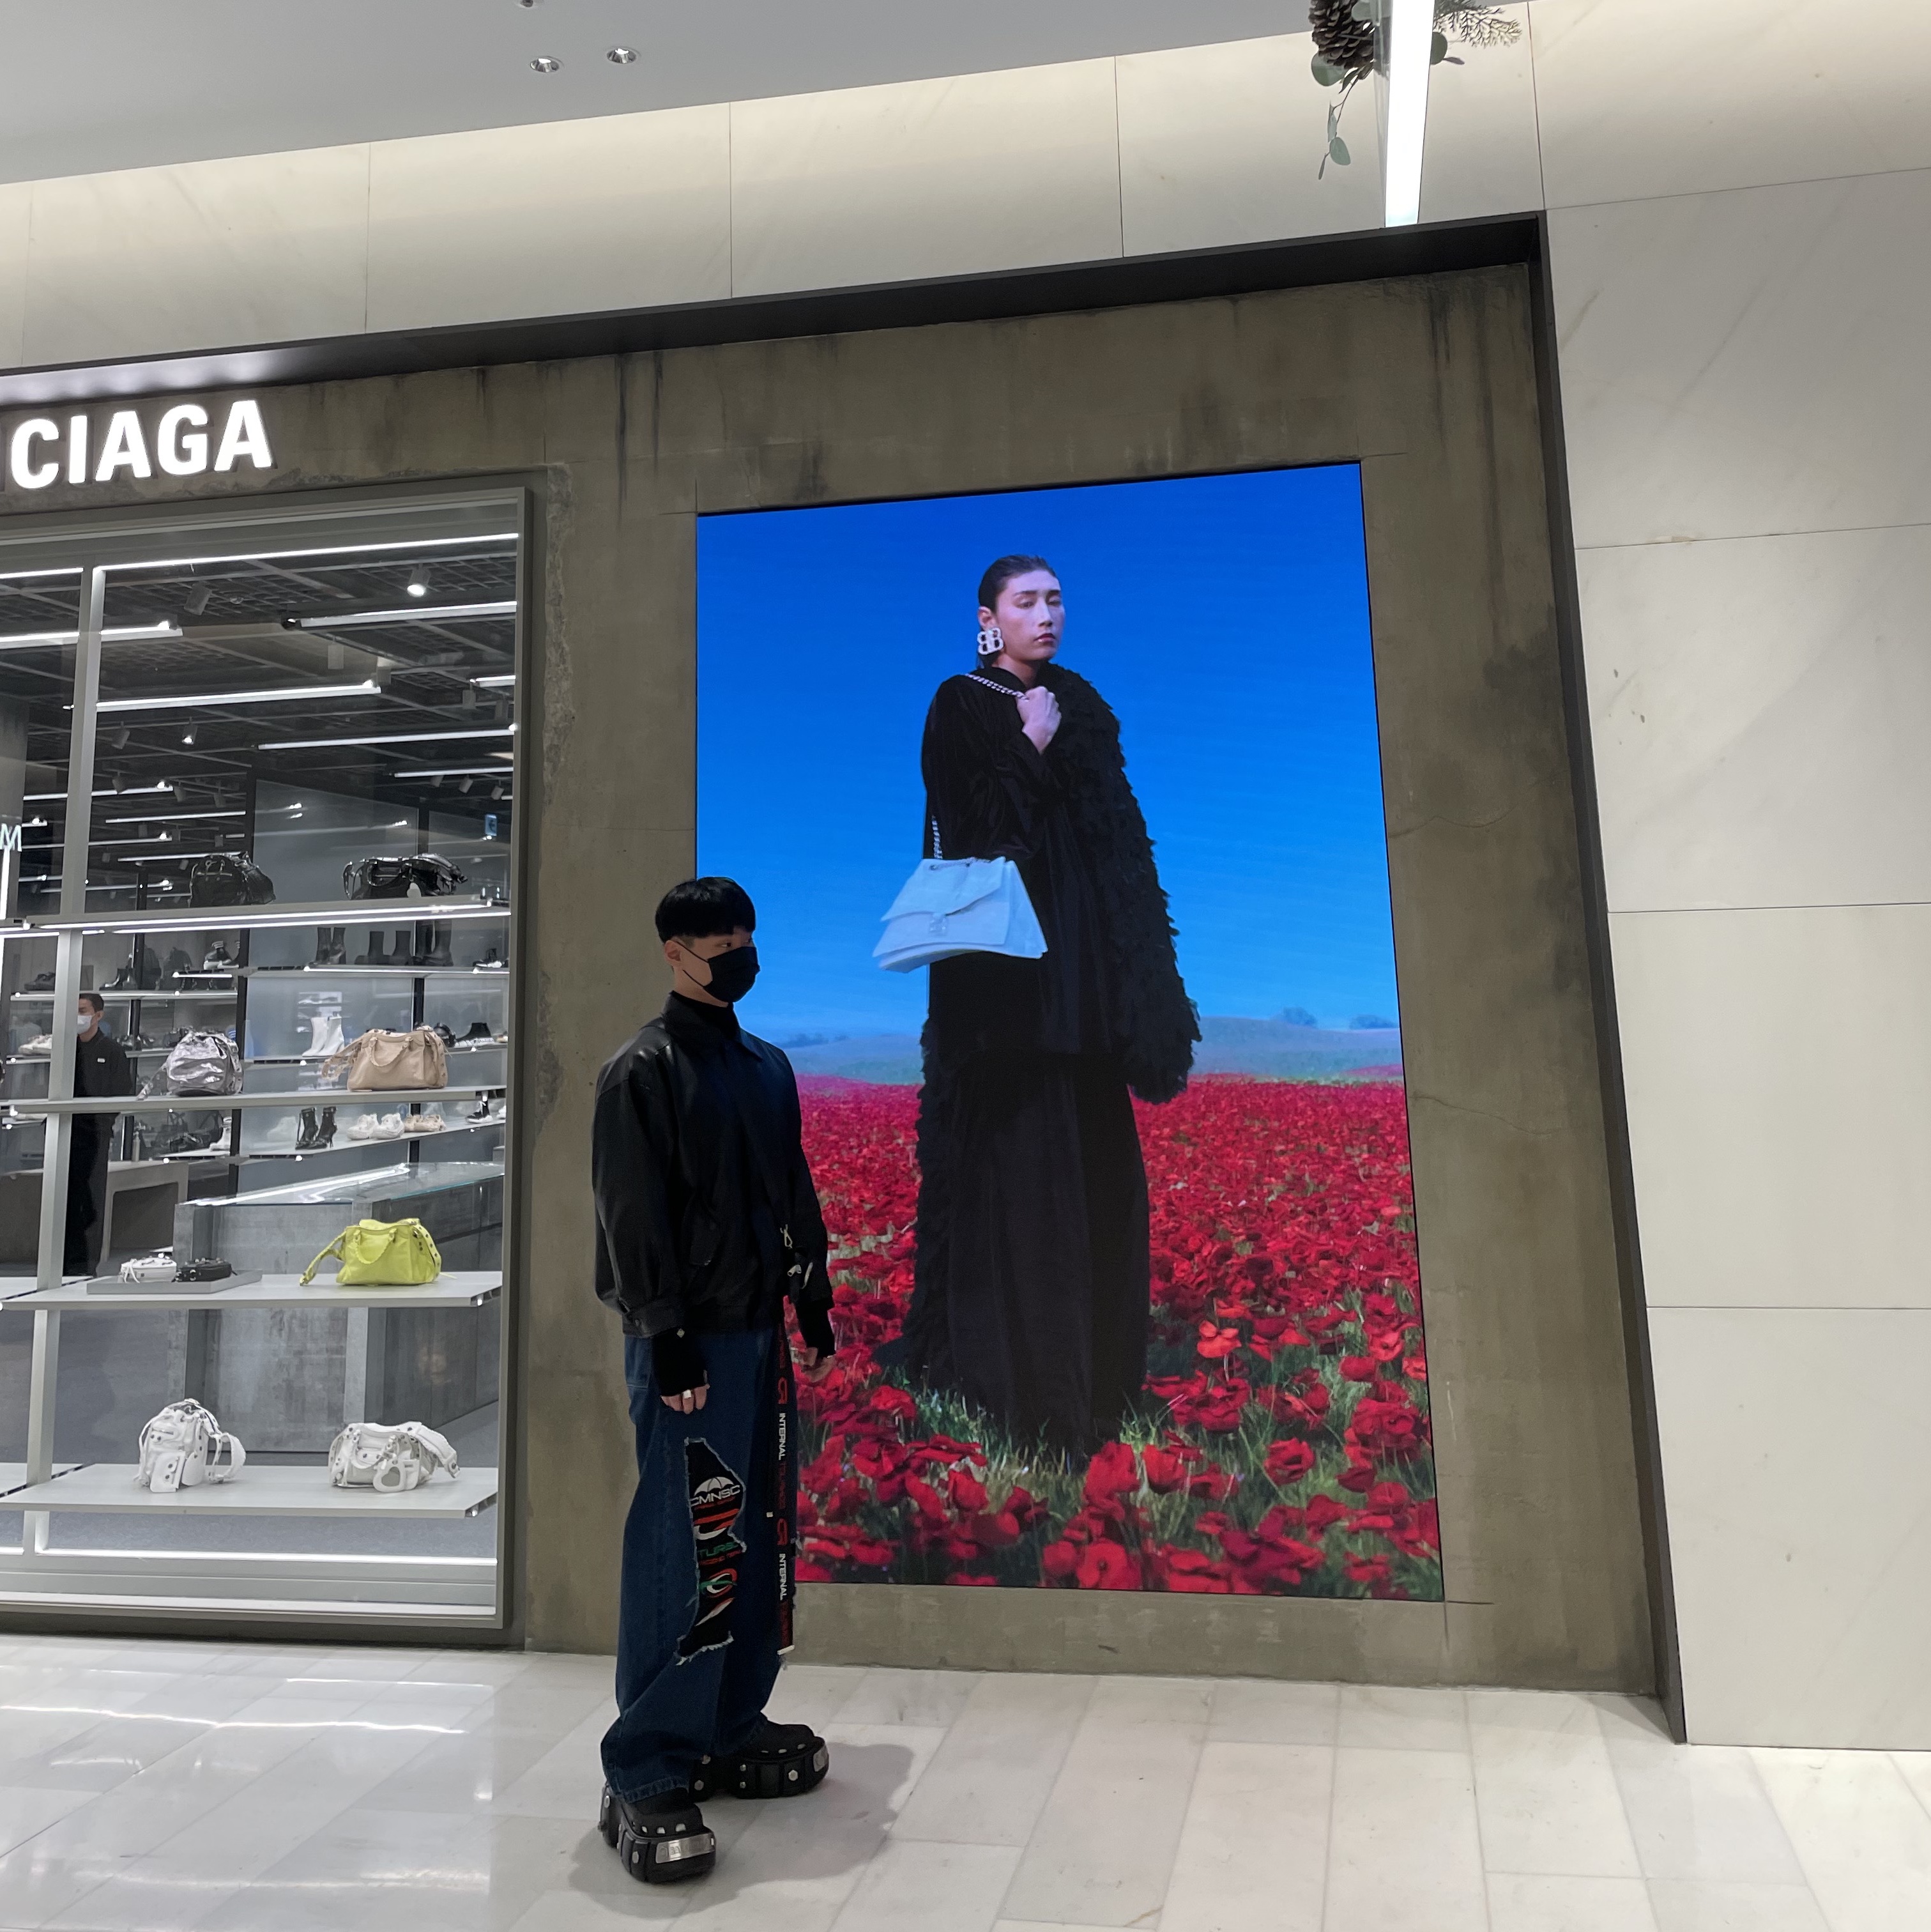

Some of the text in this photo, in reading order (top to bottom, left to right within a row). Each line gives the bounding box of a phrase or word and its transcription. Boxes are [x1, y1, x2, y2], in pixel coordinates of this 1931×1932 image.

[11, 399, 273, 489] CIAGA
[778, 1413, 786, 1461] INTERNAL
[779, 1553, 787, 1601] INTERNAL
